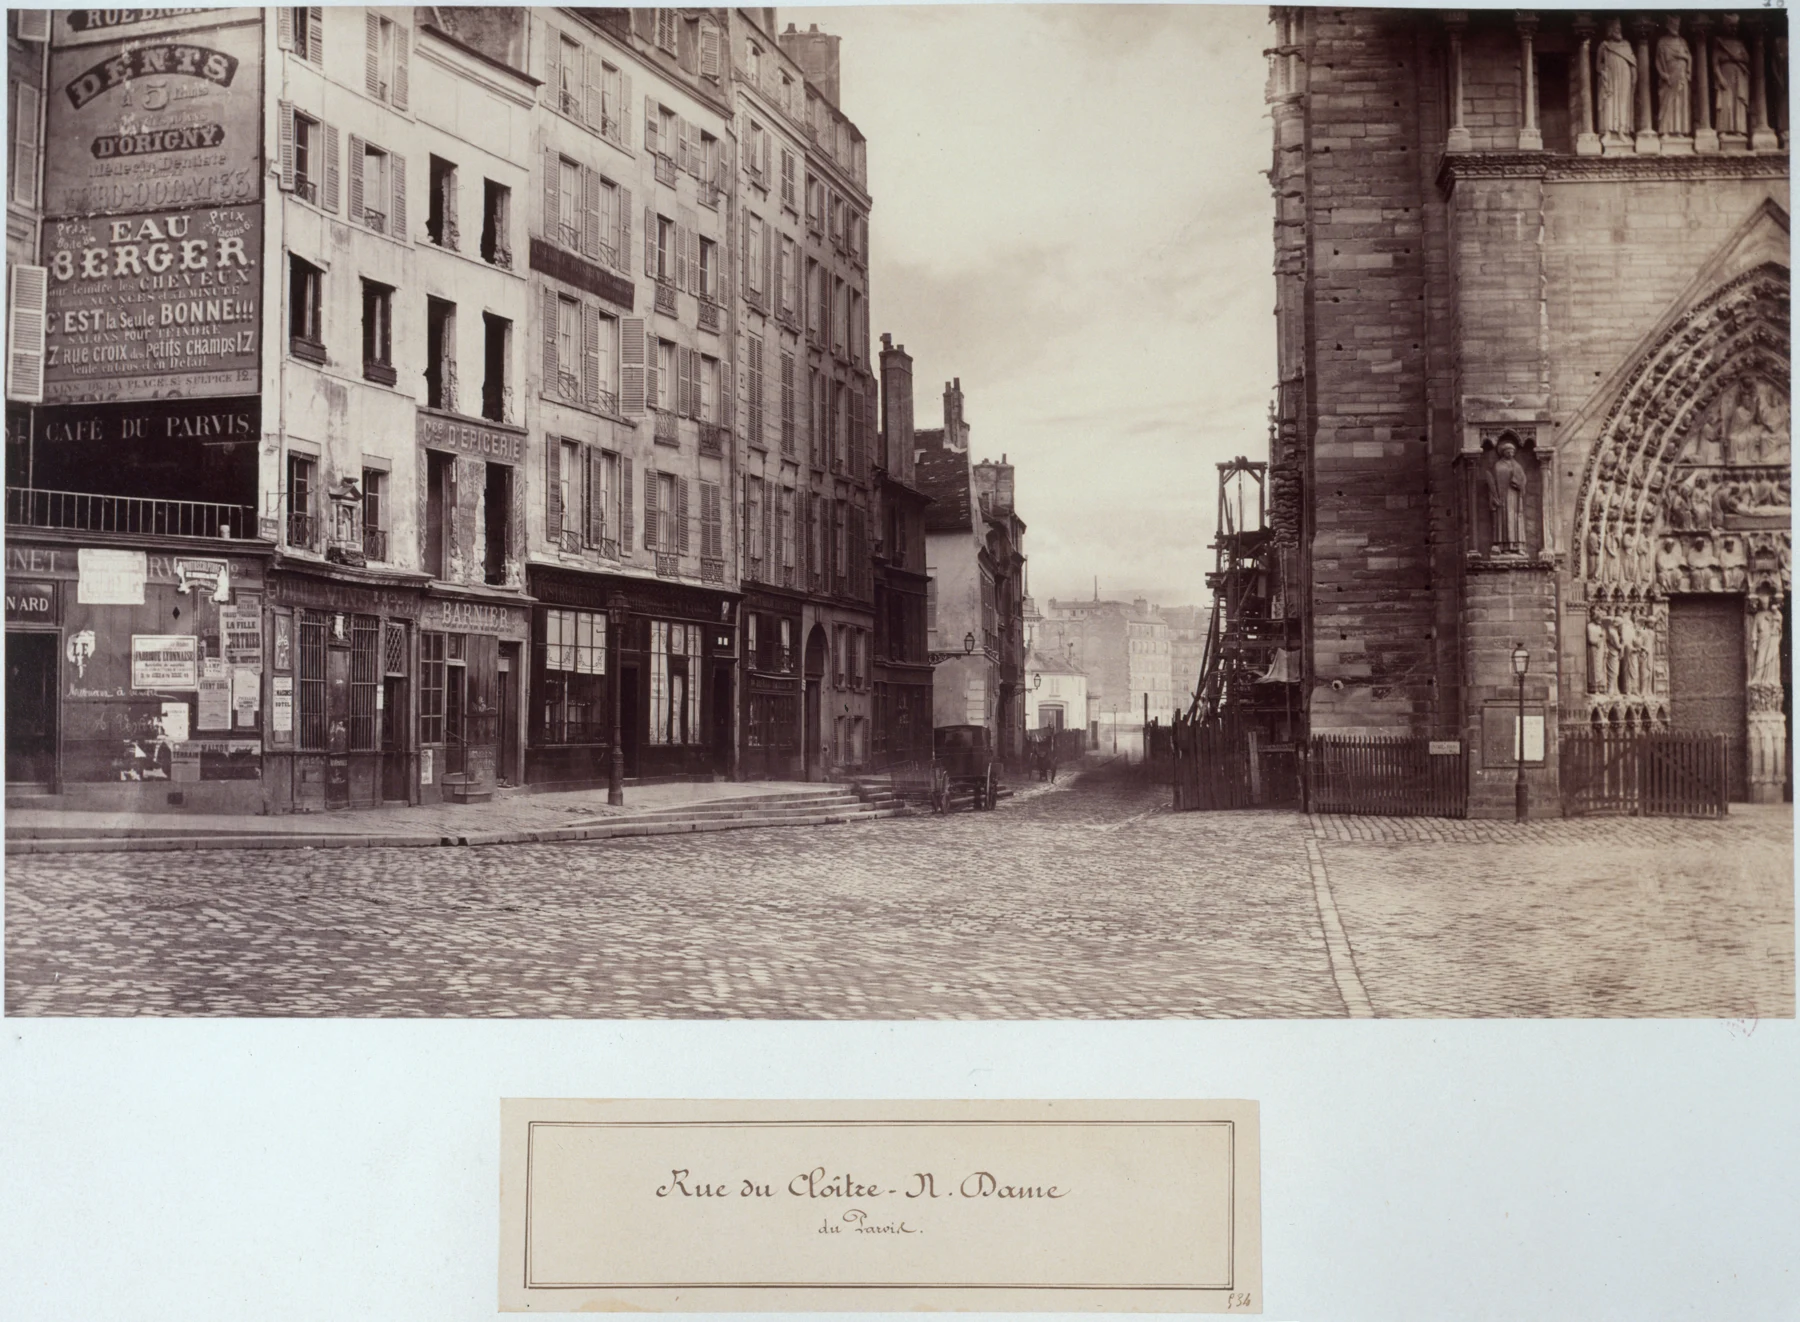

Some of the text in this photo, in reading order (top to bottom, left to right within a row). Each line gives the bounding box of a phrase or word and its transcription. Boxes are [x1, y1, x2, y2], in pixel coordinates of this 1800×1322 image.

[85, 9, 135, 28] RUE
[71, 47, 229, 104] DENTS
[100, 124, 222, 156] D'ORIGNY.
[109, 214, 190, 243] EAU
[210, 210, 245, 224] Prix
[119, 279, 134, 292] les
[140, 268, 250, 291] CHEVEUX
[188, 285, 240, 299] MINUTE
[120, 307, 155, 329] Seule
[161, 298, 254, 325] BONNE!!!
[185, 374, 233, 386] SULPICE
[122, 417, 149, 439] DU
[226, 621, 235, 629] LA
[442, 601, 509, 628] BARNIER
